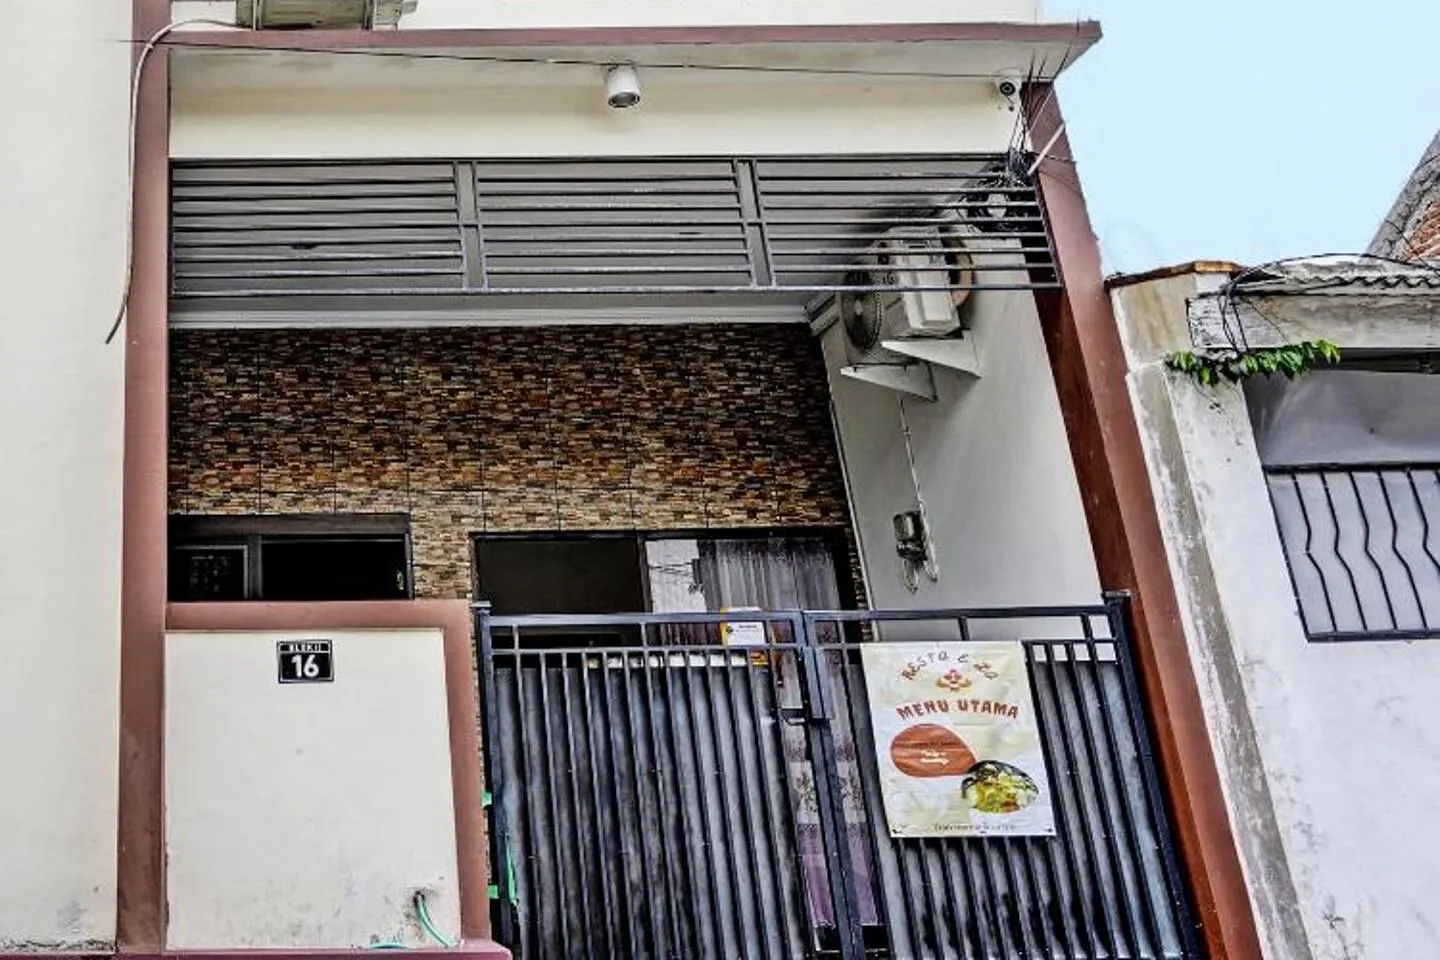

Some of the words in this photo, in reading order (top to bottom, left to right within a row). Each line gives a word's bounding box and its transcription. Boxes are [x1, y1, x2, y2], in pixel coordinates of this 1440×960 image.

[291, 654, 320, 678] 16
[896, 699, 950, 720] MENU
[956, 699, 1019, 719] UTAMA
